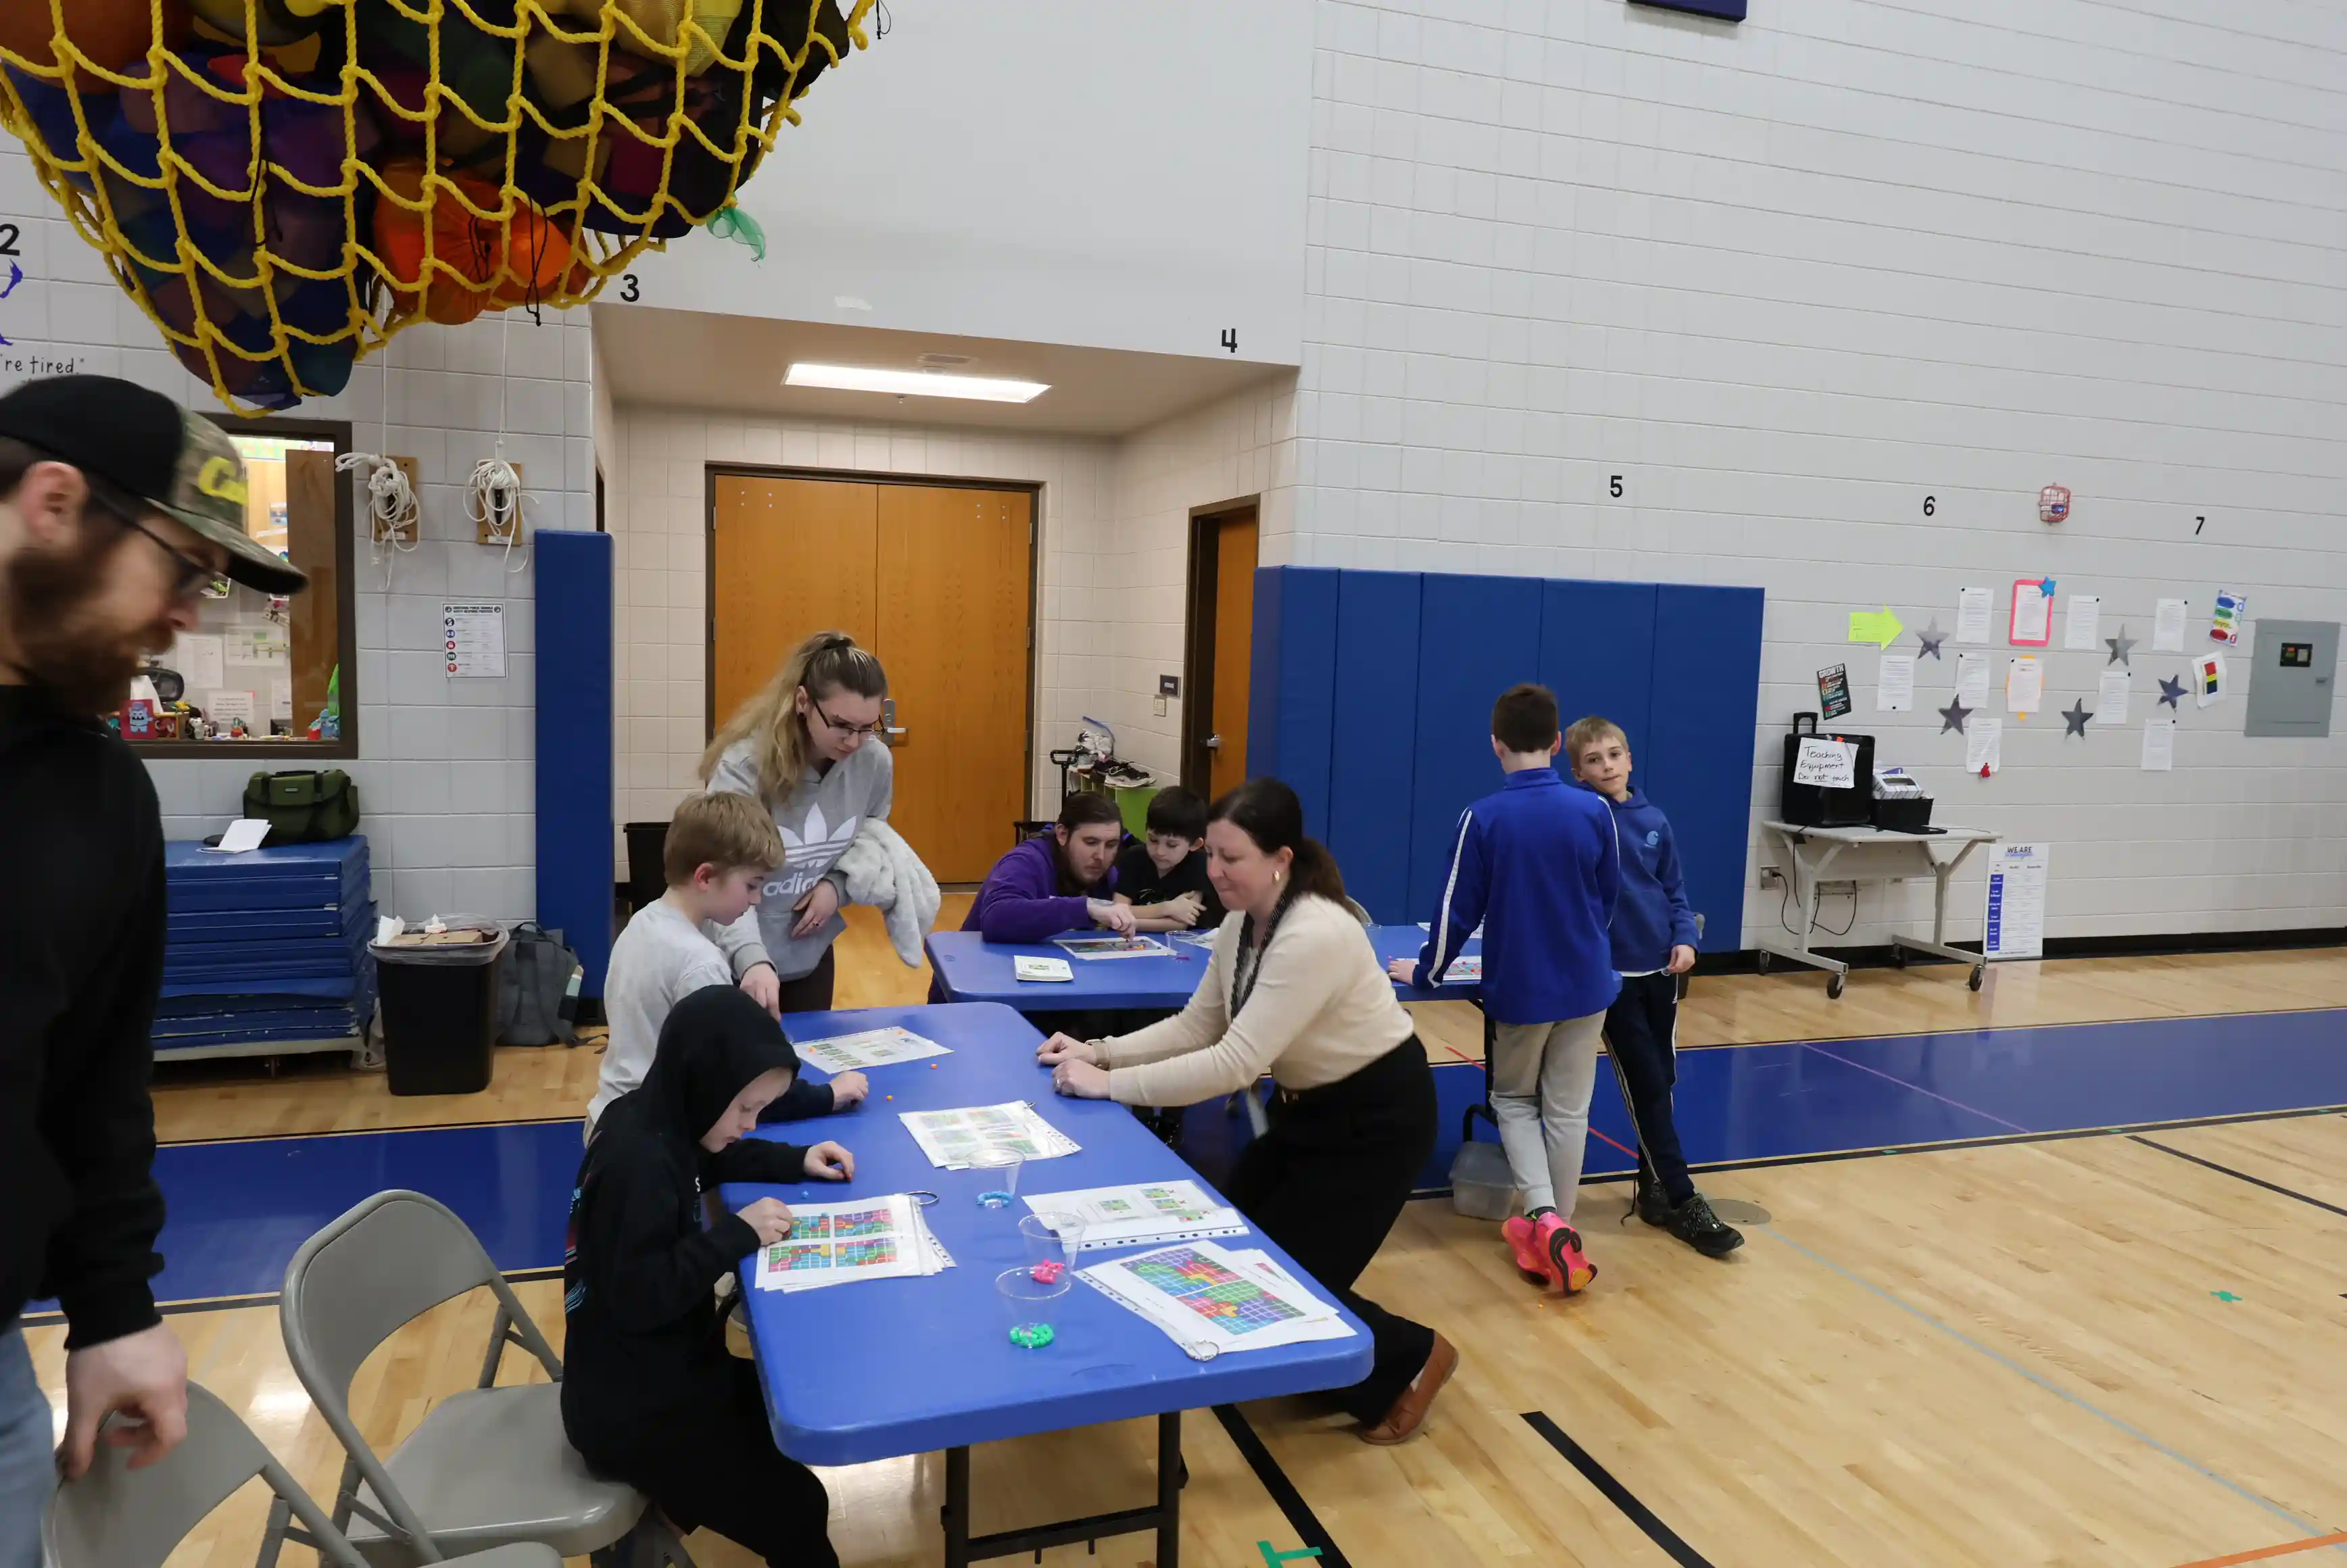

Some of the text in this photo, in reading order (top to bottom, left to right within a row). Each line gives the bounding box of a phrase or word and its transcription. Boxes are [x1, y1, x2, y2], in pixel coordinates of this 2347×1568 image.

[0, 224, 20, 256] 2
[620, 274, 639, 302] 3
[1221, 328, 1238, 353] 4
[1610, 475, 1623, 498] 5
[1923, 495, 1936, 516] 6
[2195, 516, 2205, 535] 7
[1818, 664, 1844, 678] GROWTH
[1804, 746, 1843, 761] Teaching
[1798, 772, 1808, 780] Do
[1800, 760, 1844, 772] Equipment
